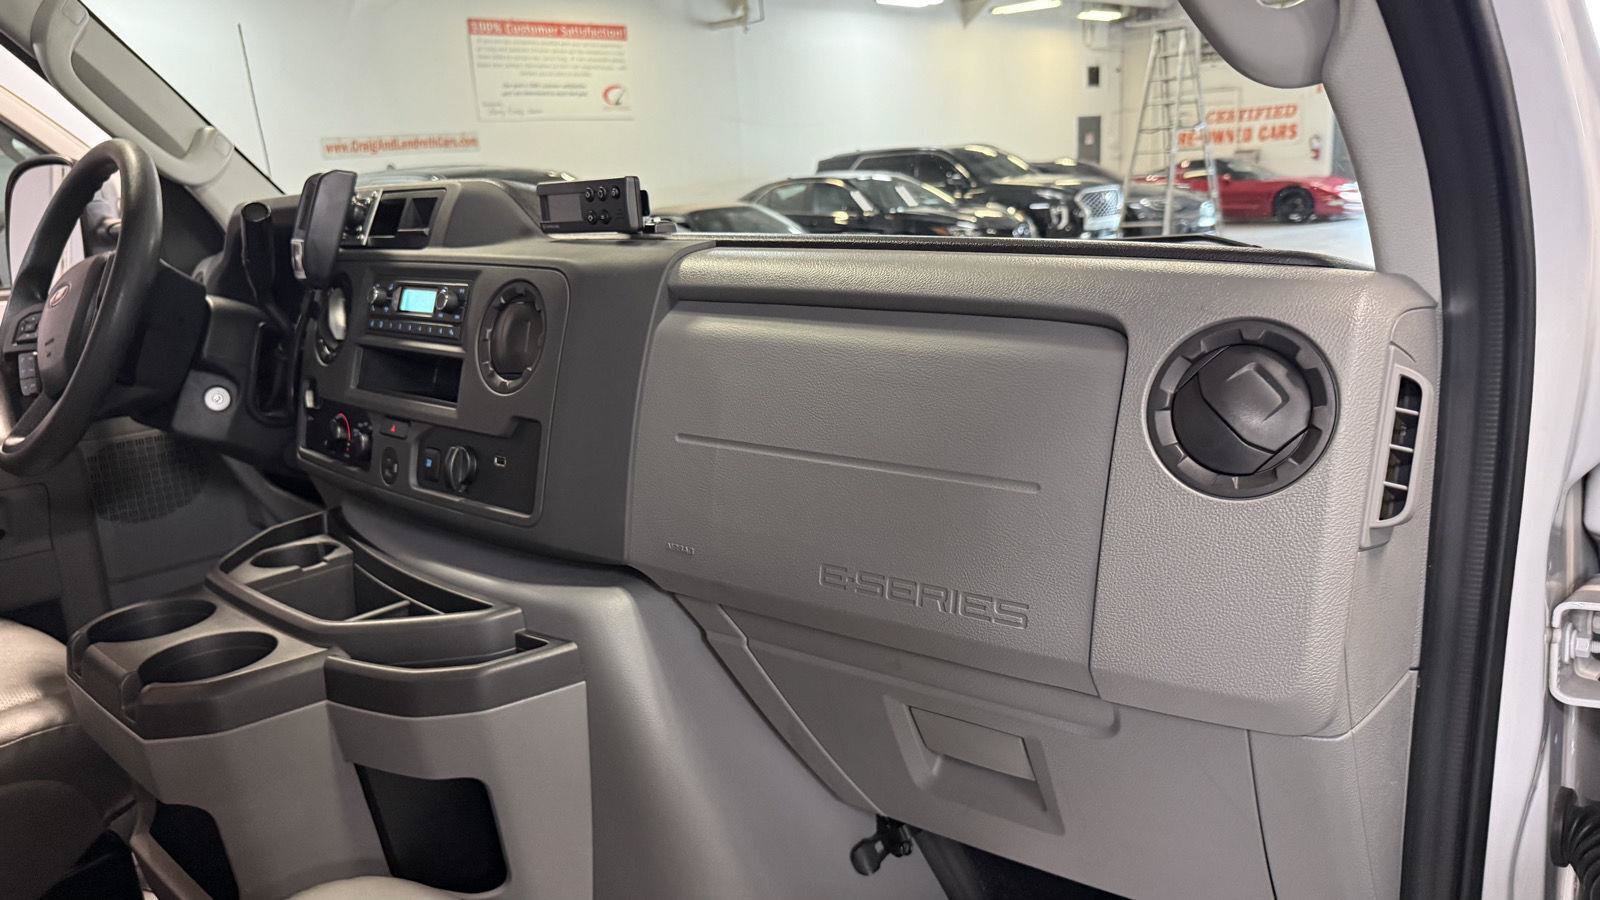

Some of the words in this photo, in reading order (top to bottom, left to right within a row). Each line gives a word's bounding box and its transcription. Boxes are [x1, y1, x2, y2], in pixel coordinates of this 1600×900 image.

[470, 21, 500, 33] 100%
[505, 23, 557, 35] Customer
[1205, 105, 1297, 124] CERTIFIED
[1258, 124, 1297, 142] CARS
[819, 563, 1030, 630] E-SERIES
